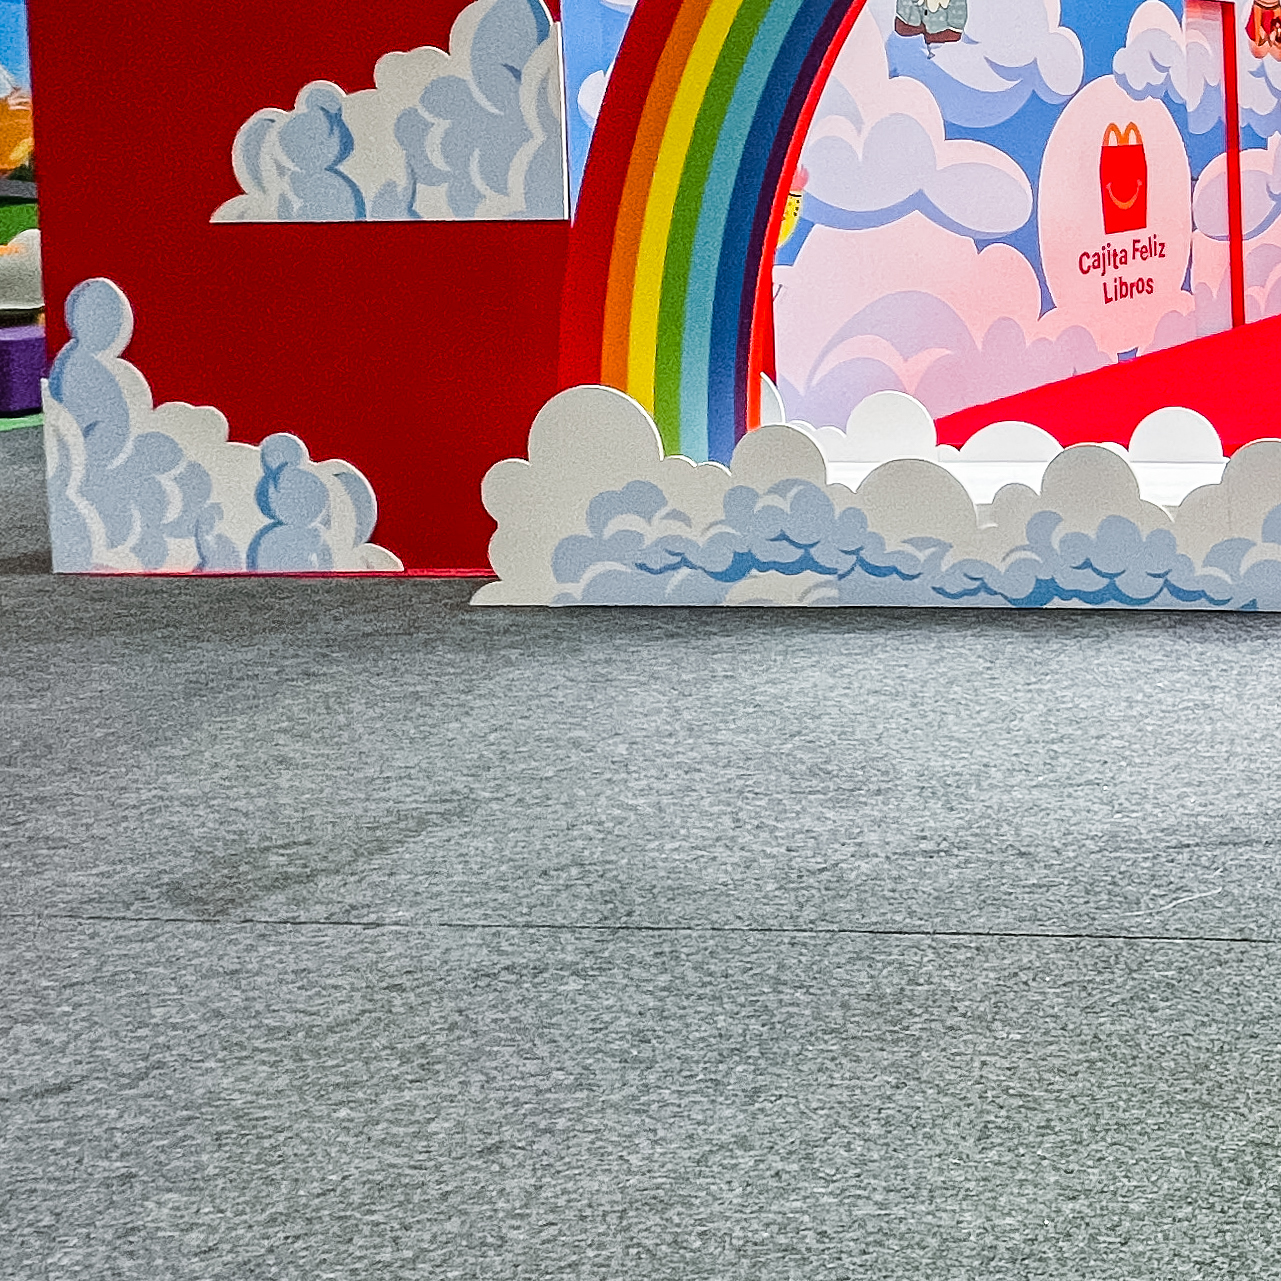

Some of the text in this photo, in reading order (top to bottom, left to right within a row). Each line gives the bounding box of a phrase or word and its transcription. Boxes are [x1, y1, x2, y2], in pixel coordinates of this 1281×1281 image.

[1078, 234, 1166, 276] Cajita Feliz
[1102, 277, 1154, 304] Libros
